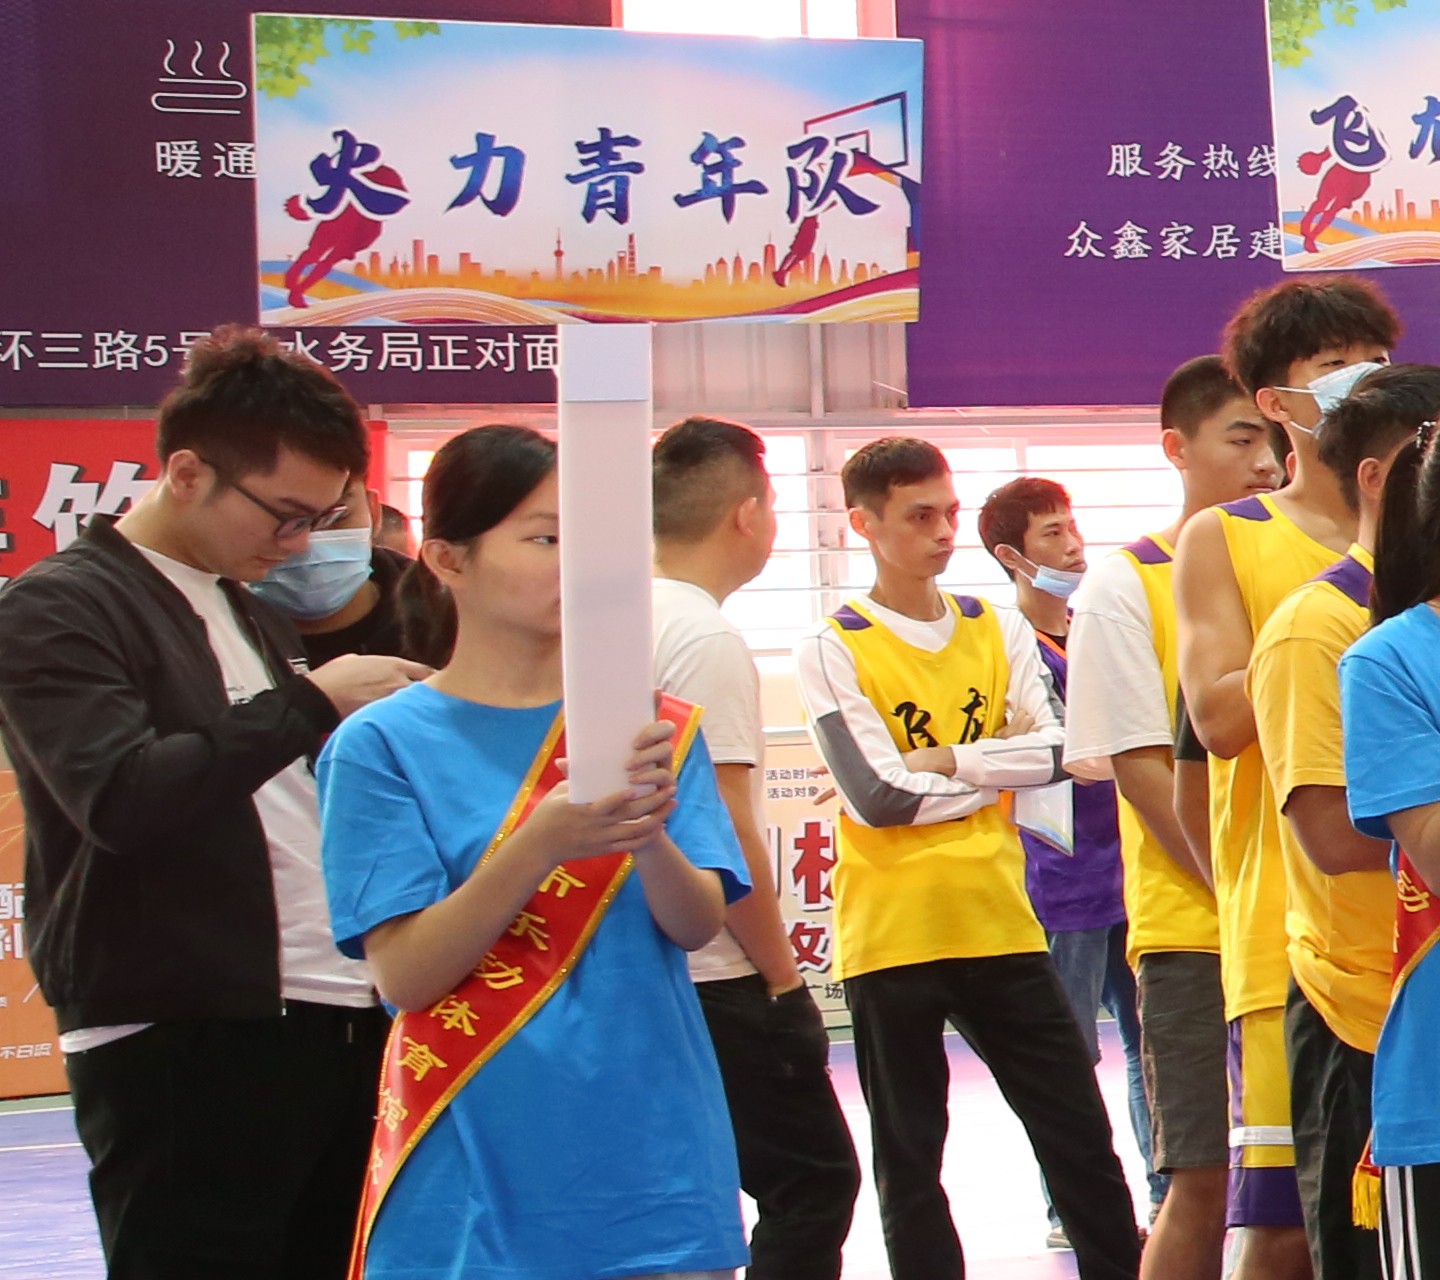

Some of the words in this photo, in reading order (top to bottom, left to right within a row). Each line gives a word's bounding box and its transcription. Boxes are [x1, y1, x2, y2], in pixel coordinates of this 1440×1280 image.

[306, 126, 881, 225] 火力青年队
